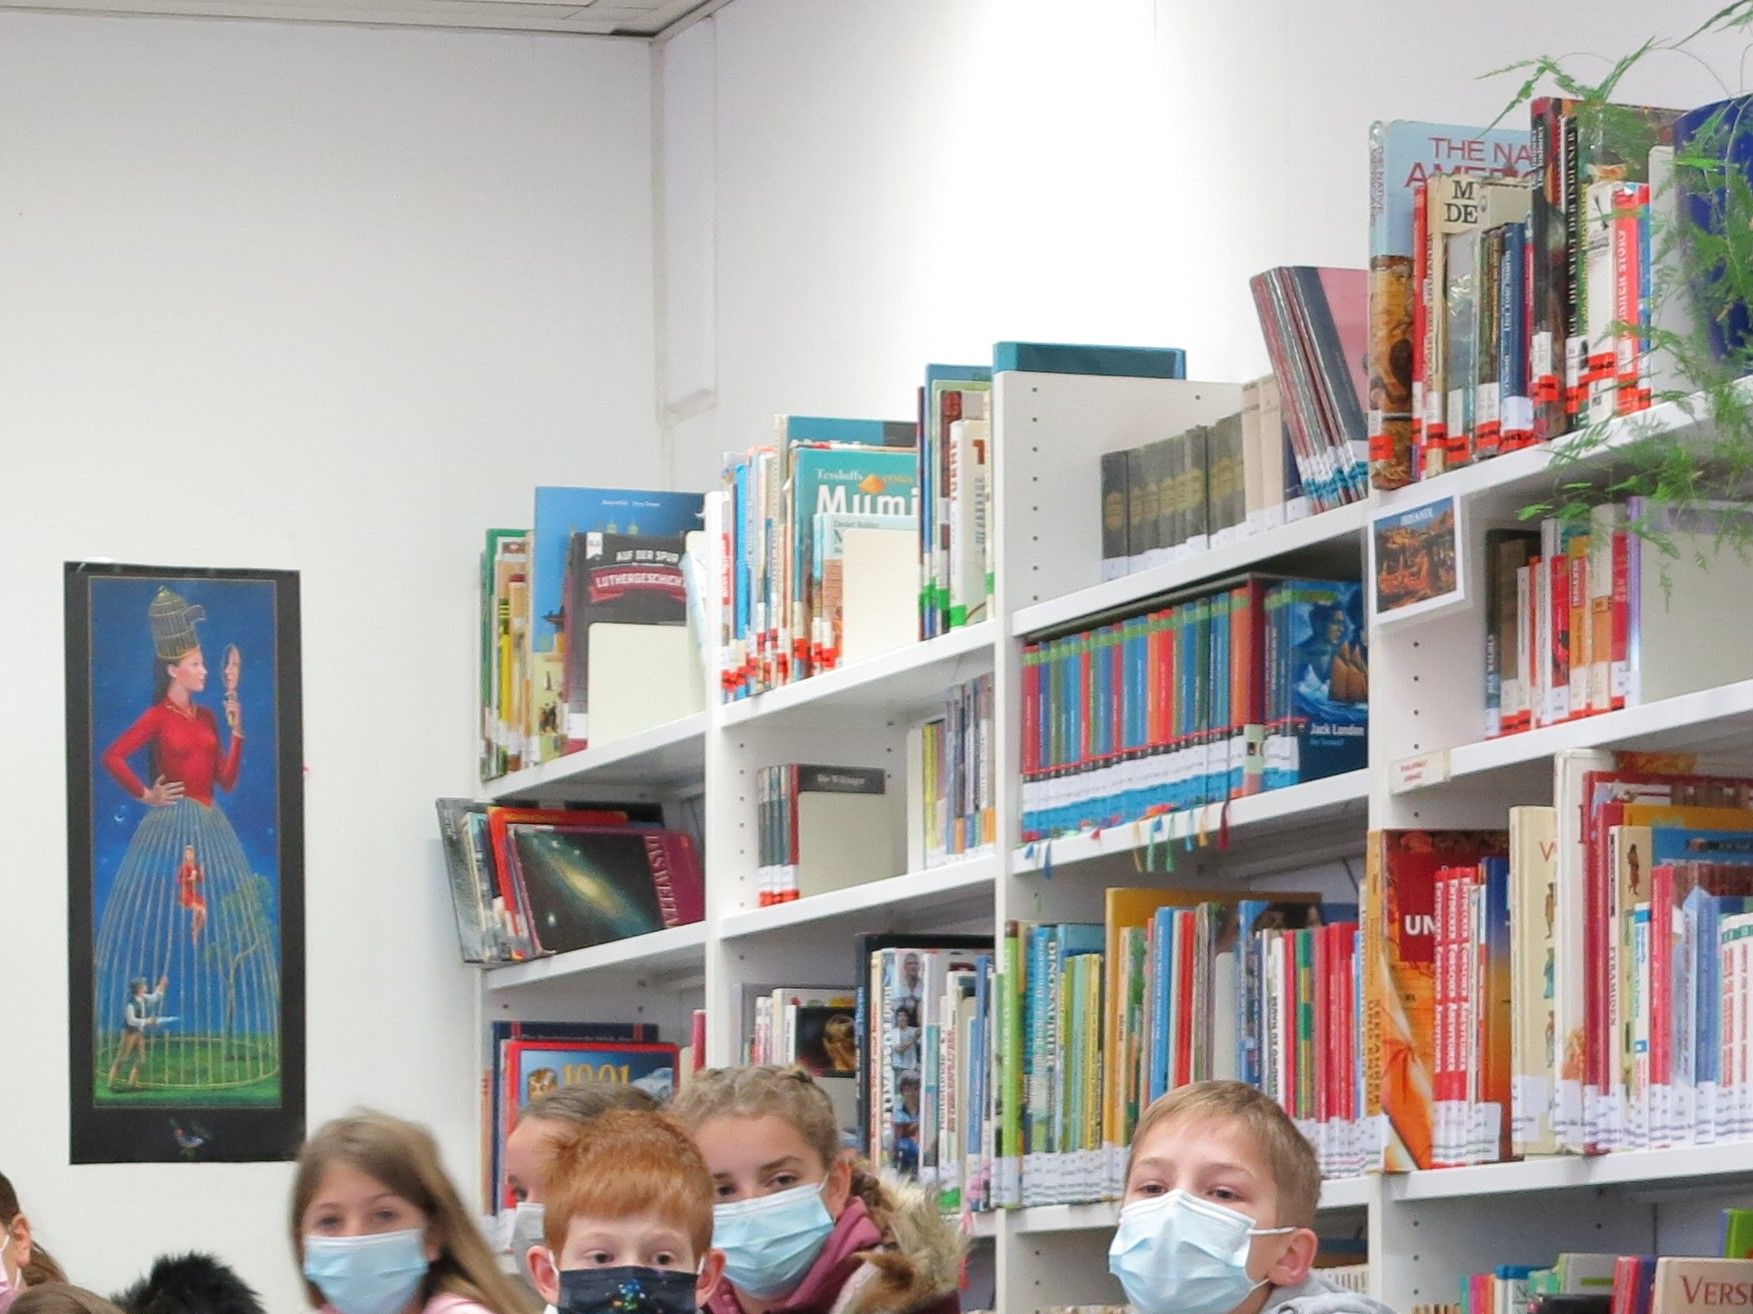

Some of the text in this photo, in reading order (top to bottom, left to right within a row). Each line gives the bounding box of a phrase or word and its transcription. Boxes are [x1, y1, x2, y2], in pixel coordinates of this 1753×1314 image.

[1429, 136, 1533, 164] THE NA
[1451, 181, 1475, 200] M
[1444, 203, 1478, 224] DE
[816, 485, 921, 514] Mumi
[1539, 841, 1555, 862] V
[1405, 914, 1437, 936] UN
[1047, 941, 1057, 1067] DINOSAURIER
[1680, 1275, 1753, 1306] VERS
